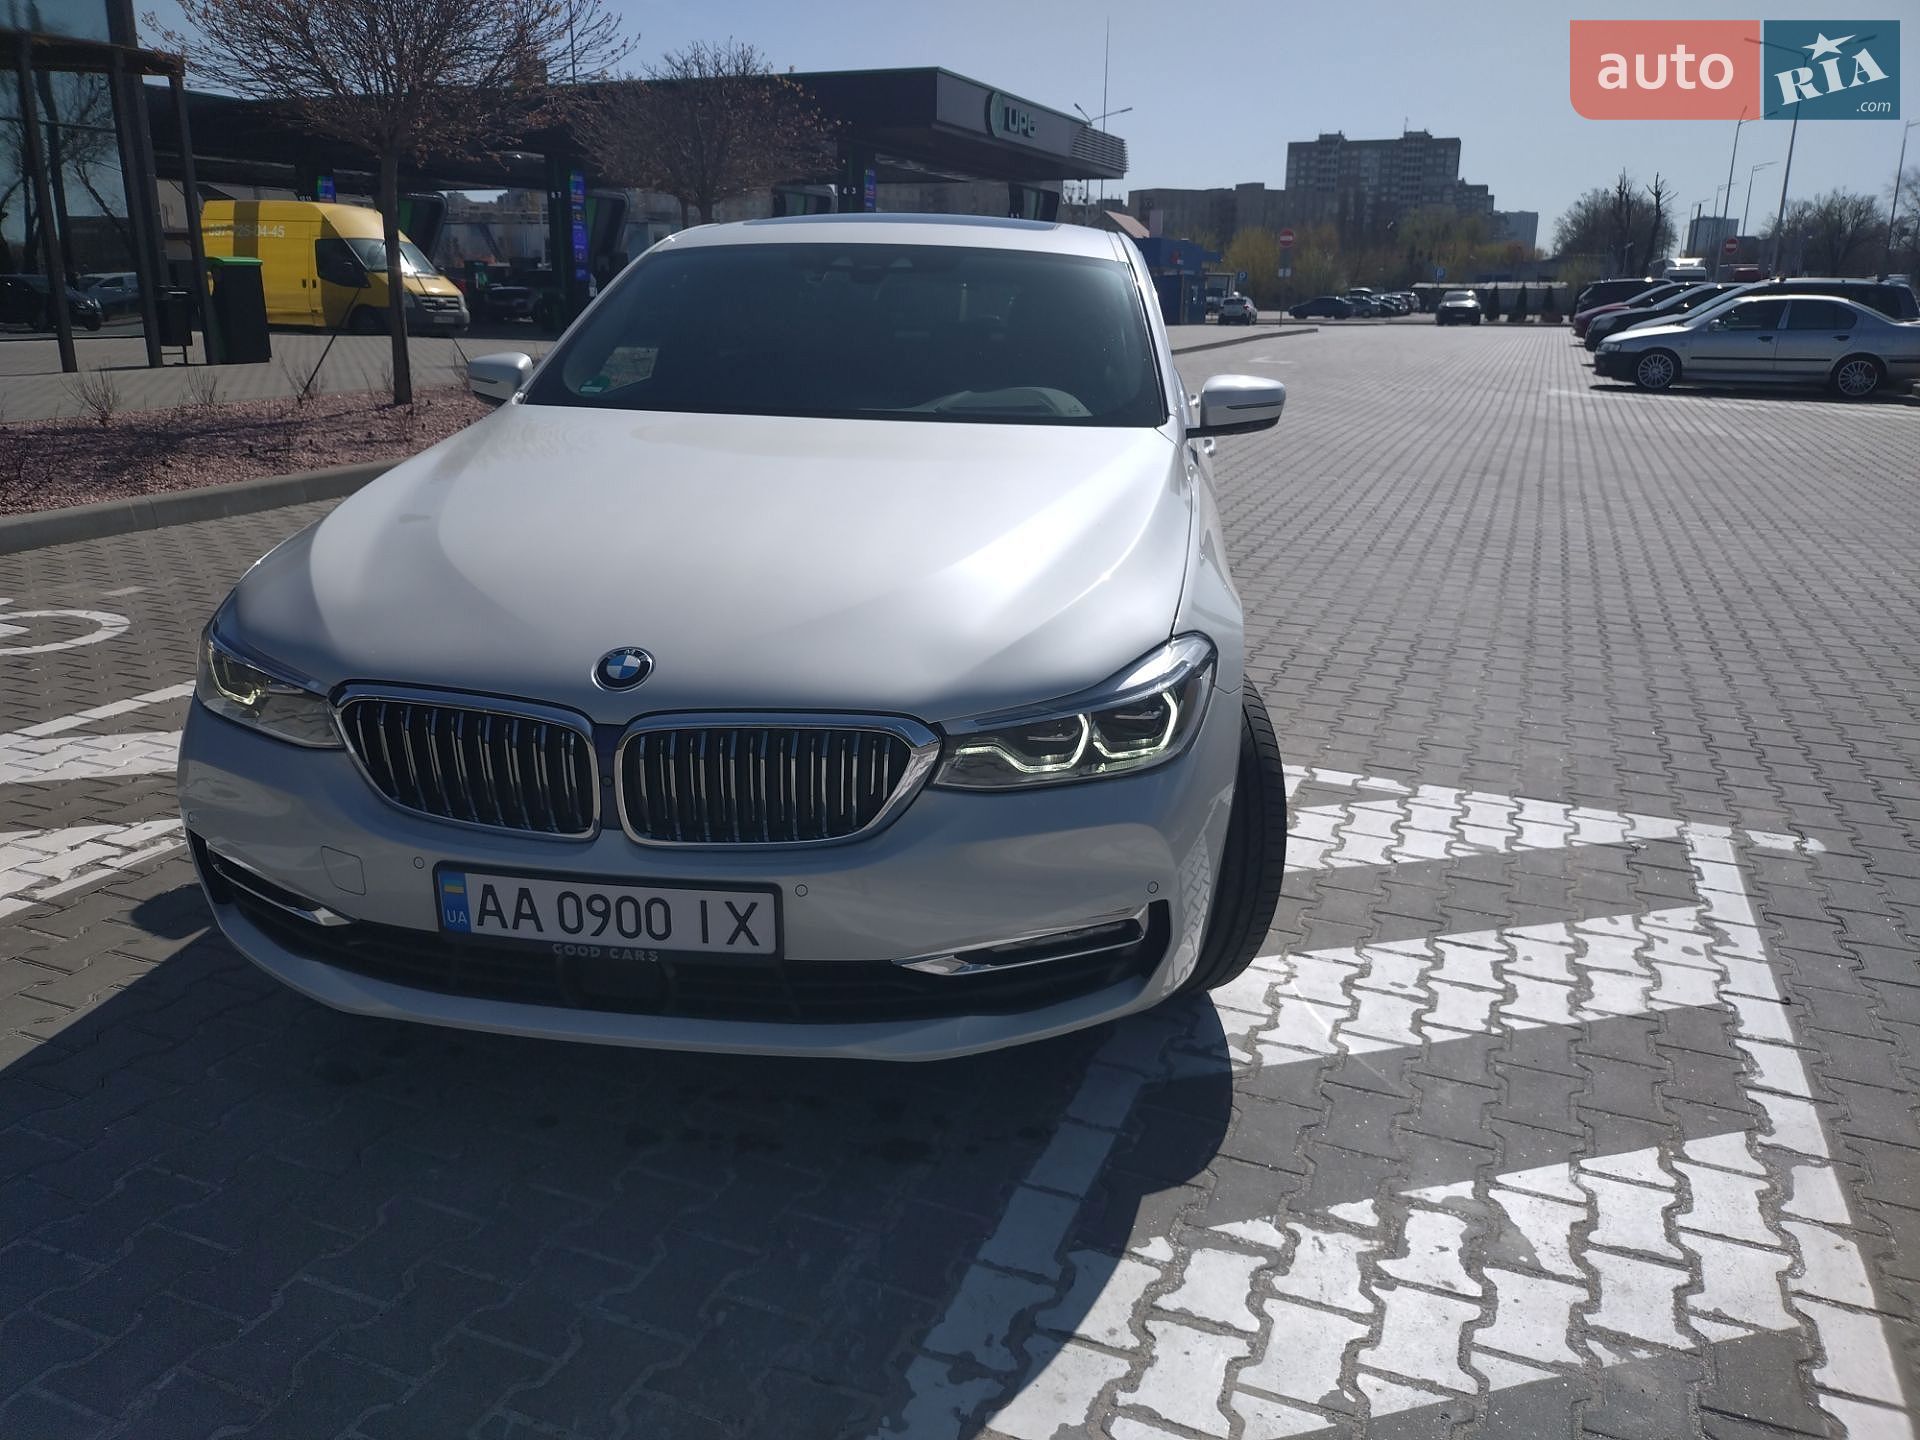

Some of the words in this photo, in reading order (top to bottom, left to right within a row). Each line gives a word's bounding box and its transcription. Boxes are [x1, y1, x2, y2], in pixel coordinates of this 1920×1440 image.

[446, 908, 468, 925] UA
[477, 883, 544, 933] AA
[557, 890, 673, 941] 0900
[552, 943, 601, 958] GOOD
[608, 947, 659, 962] CARS
